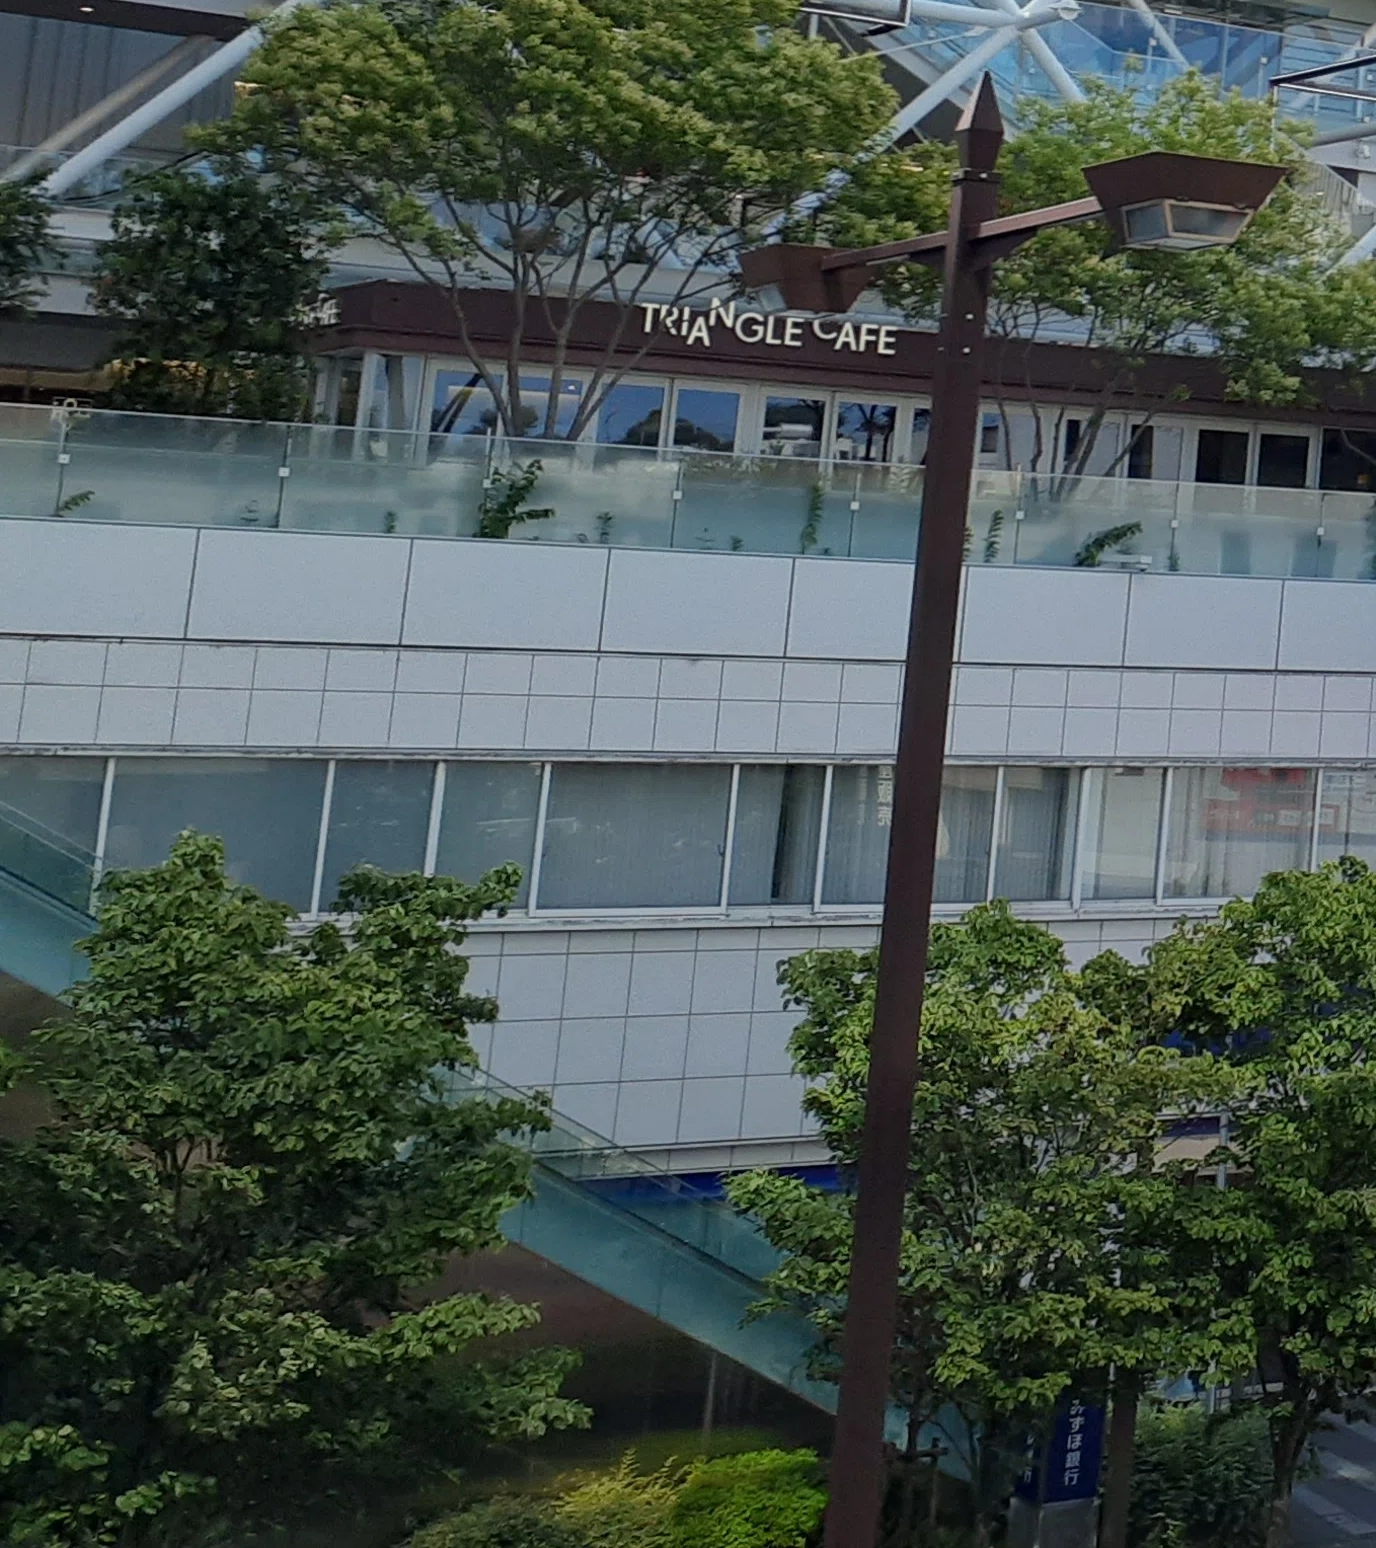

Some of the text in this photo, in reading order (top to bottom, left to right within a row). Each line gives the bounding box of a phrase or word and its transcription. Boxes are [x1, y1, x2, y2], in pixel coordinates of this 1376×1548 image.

[641, 297, 898, 355] TRIANGLE CAFE
[1064, 1399, 1086, 1486] みずほ銀行
